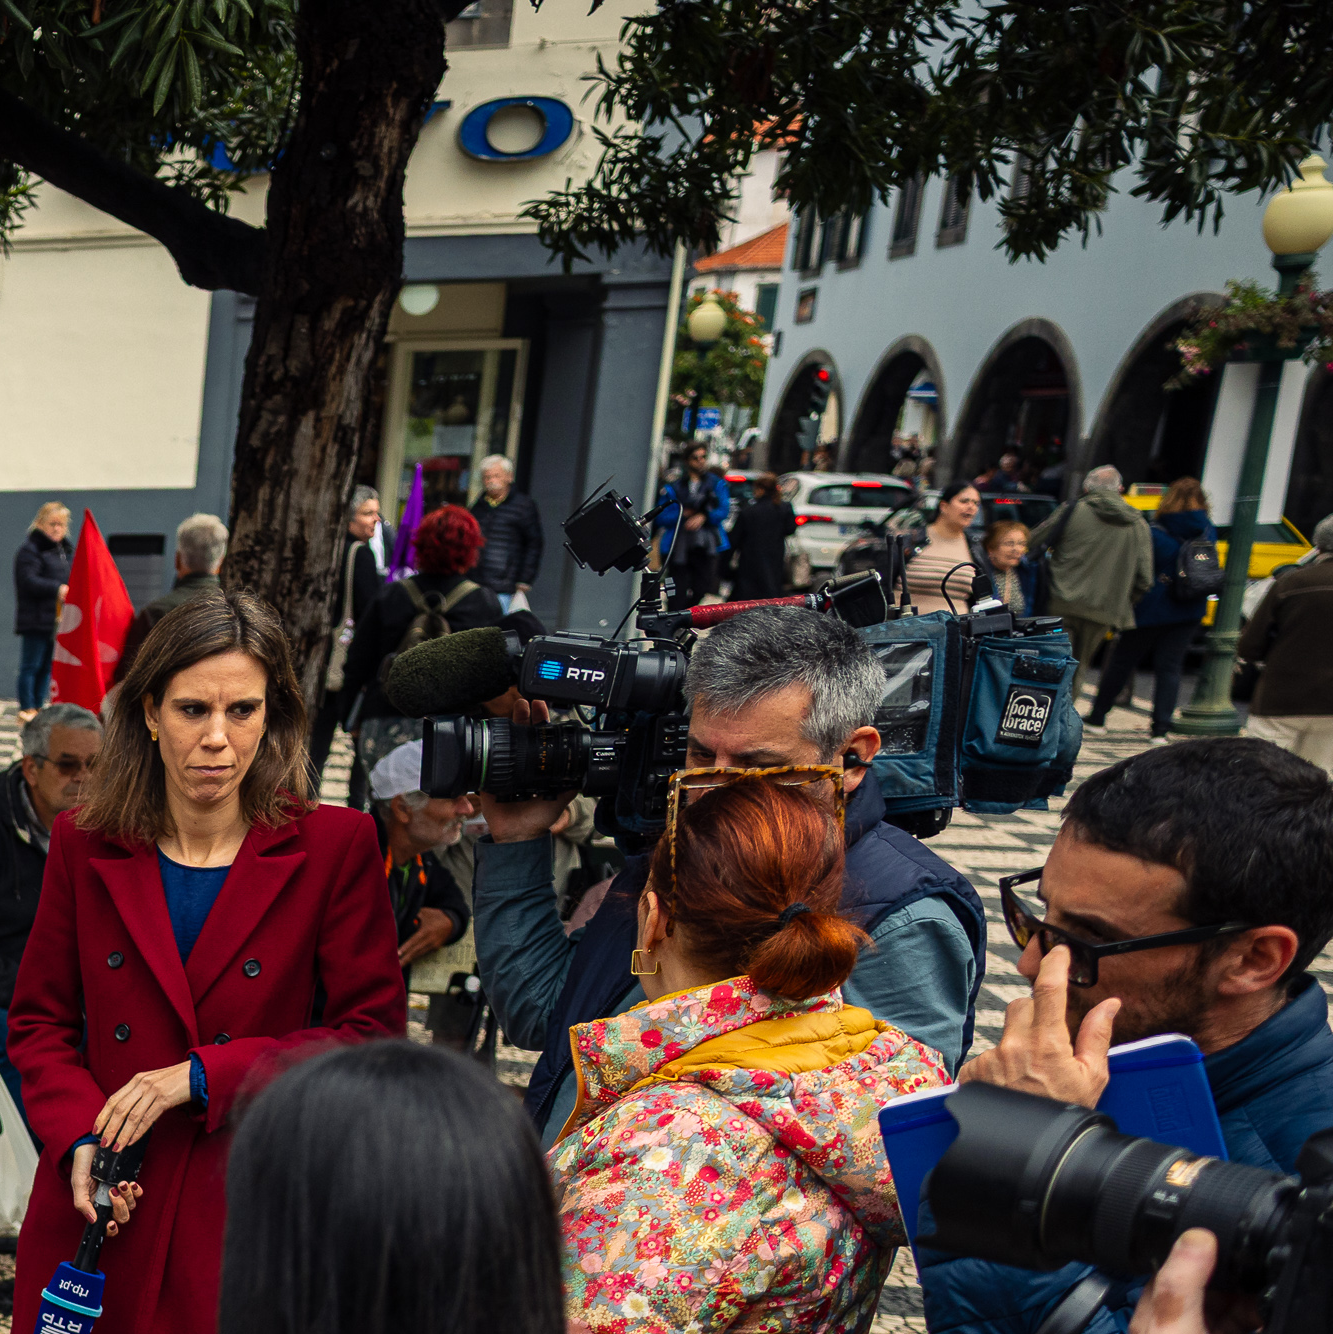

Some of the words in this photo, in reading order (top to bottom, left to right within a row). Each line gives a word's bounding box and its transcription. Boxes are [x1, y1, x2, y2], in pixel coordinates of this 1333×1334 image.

[567, 667, 605, 682] RTP
[1008, 703, 1046, 719] porta
[1005, 715, 1042, 732] brace
[58, 1279, 89, 1297] rtp.pt
[41, 1312, 83, 1334] RTP
